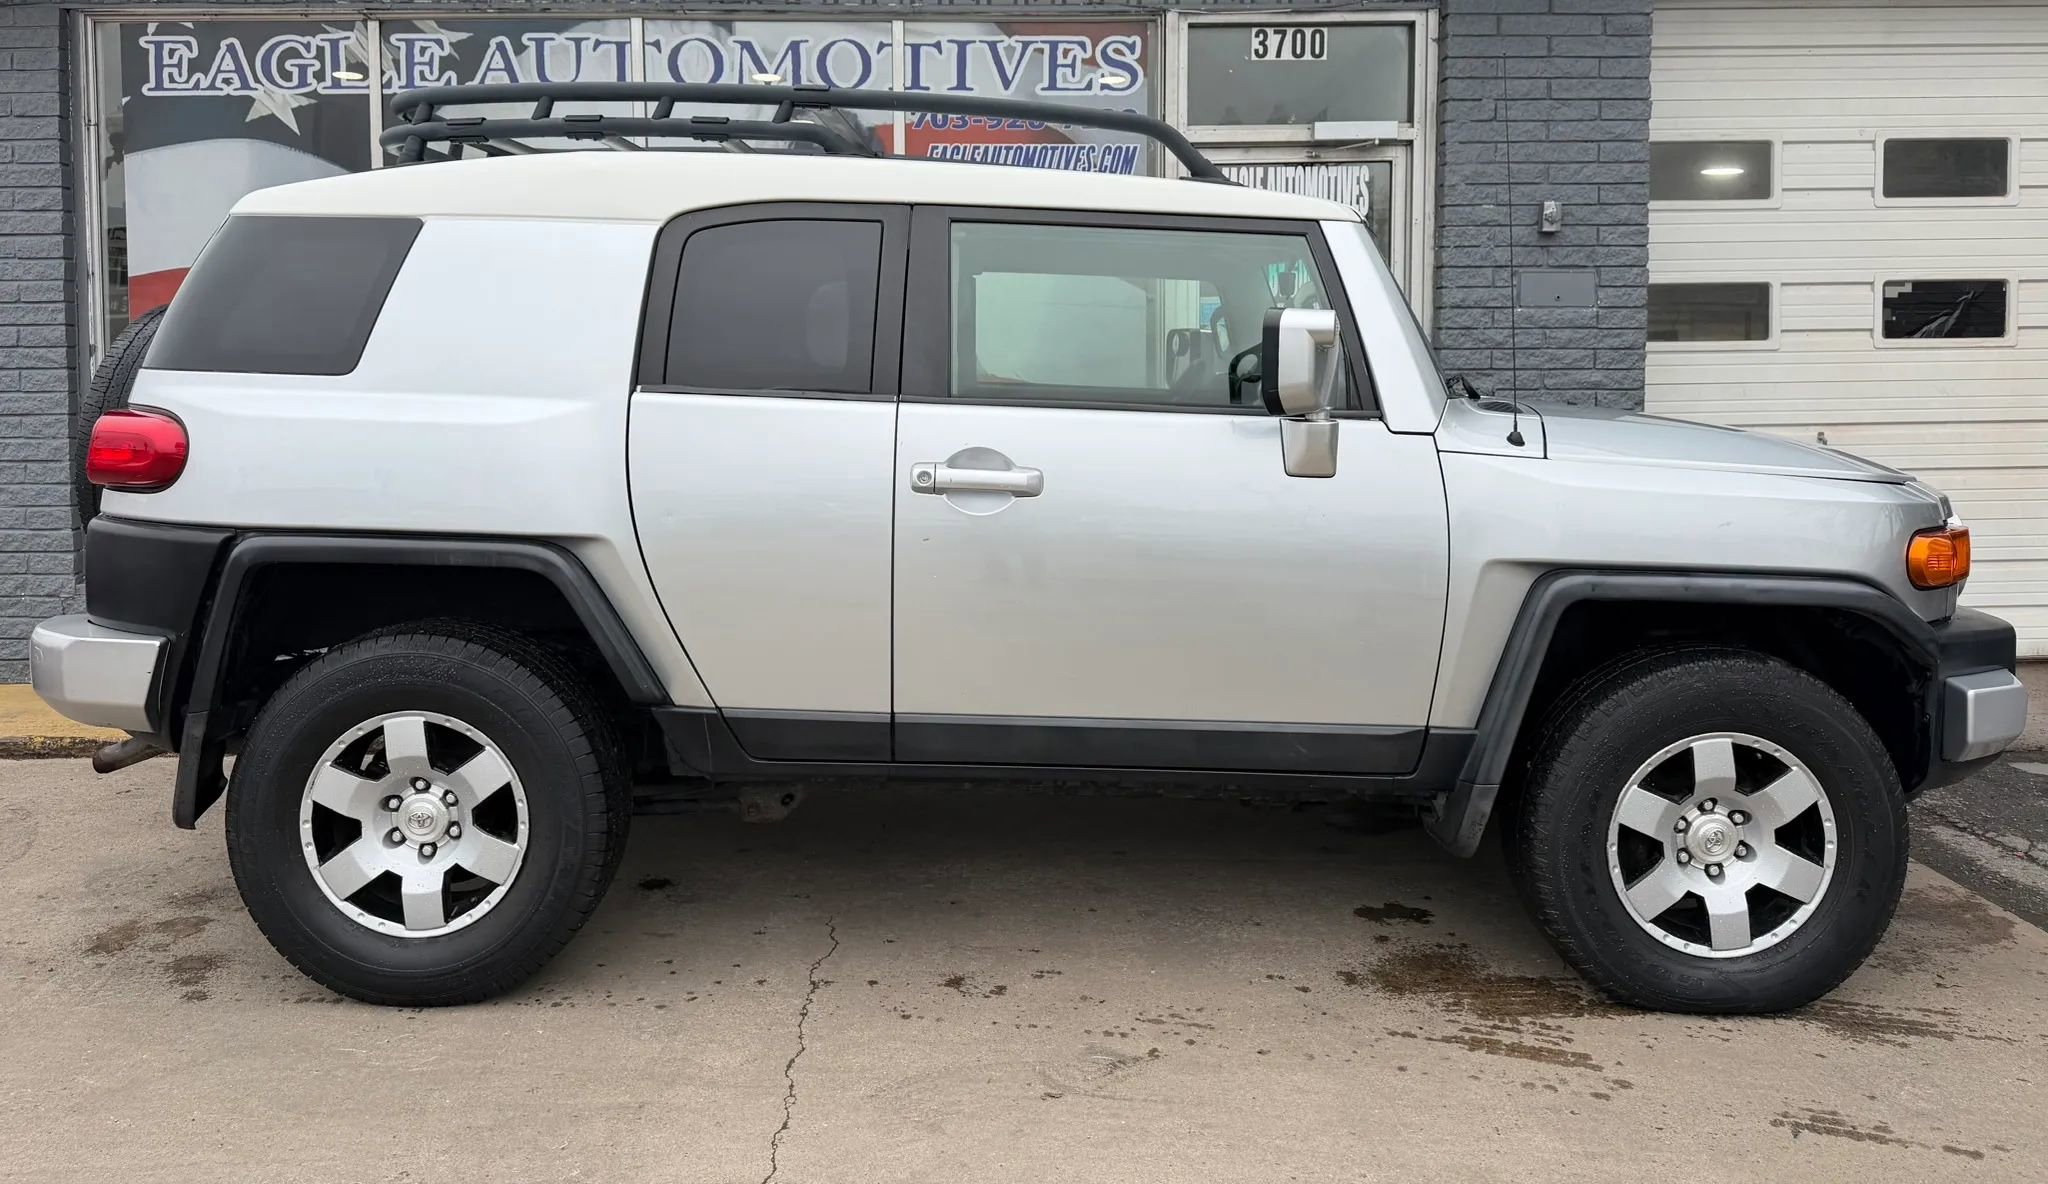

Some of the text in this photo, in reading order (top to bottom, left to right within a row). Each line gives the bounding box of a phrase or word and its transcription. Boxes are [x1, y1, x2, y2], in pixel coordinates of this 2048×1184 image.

[140, 33, 1143, 97] EAGLE AUTOMOTIVES
[1253, 28, 1326, 59] 3700
